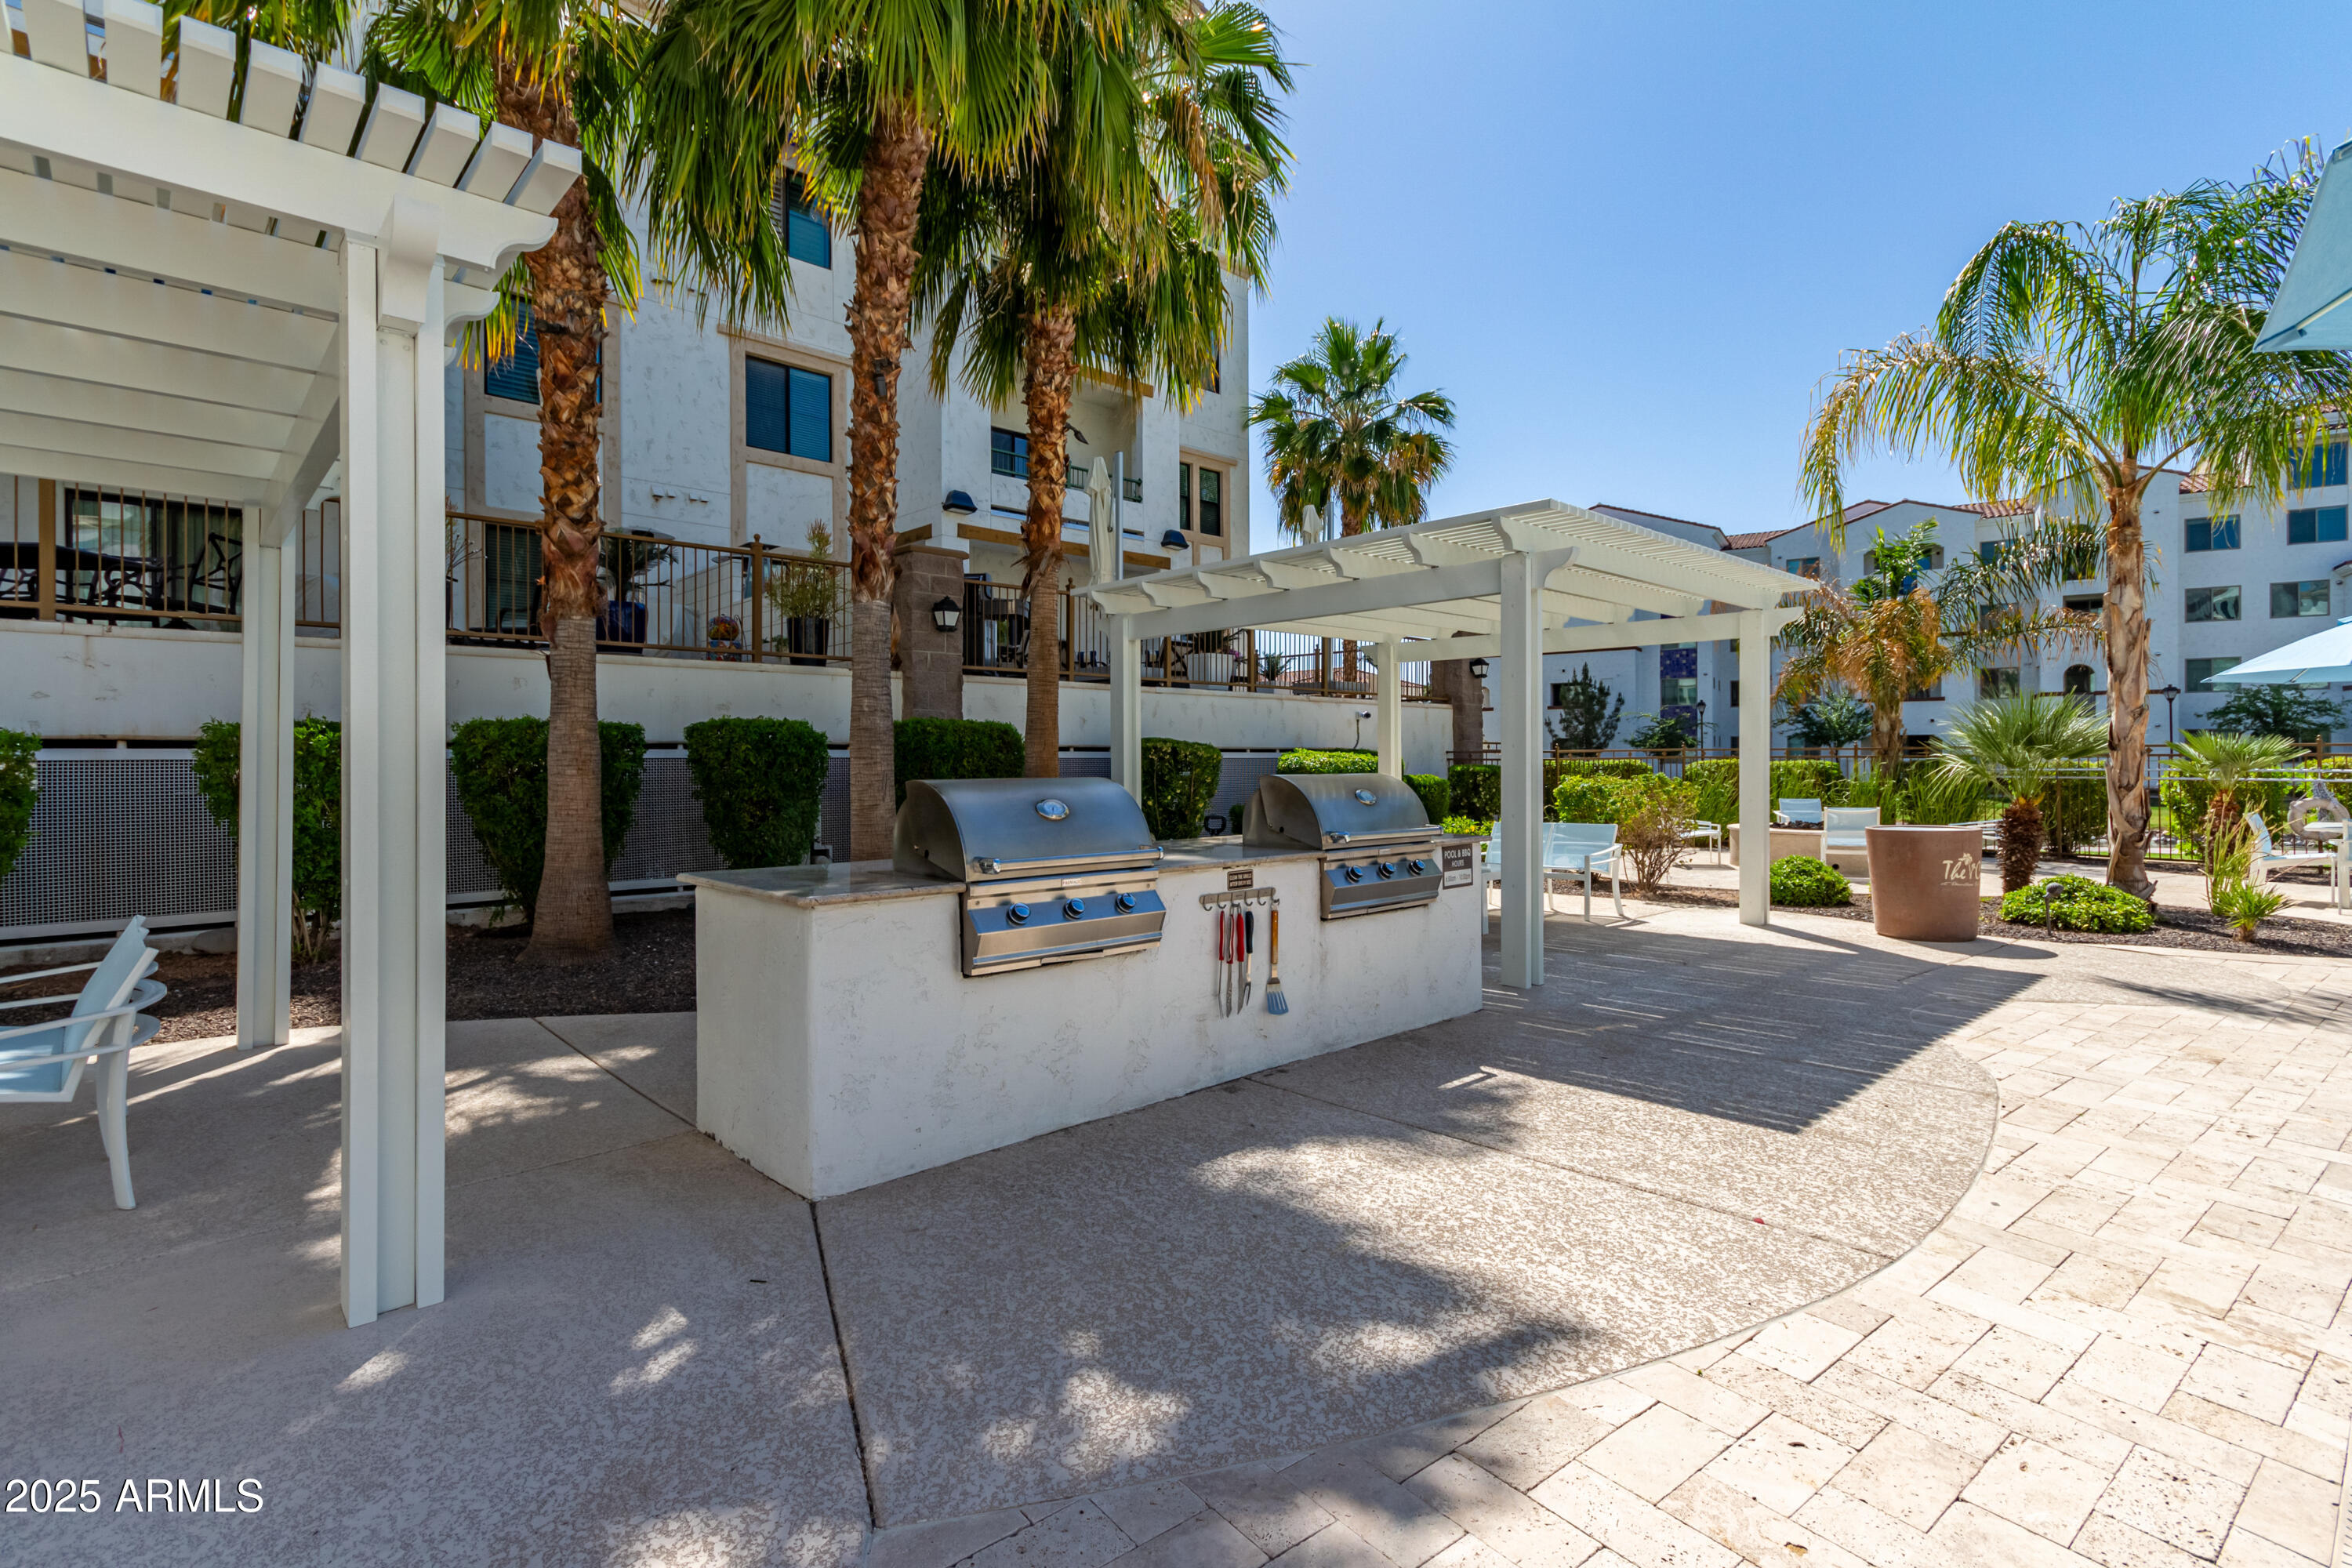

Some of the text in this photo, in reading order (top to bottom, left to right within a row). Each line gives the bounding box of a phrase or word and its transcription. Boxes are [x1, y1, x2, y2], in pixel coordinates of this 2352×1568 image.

[1444, 848, 1471, 859] POOL & BBQ
[1942, 860, 1966, 880] The
